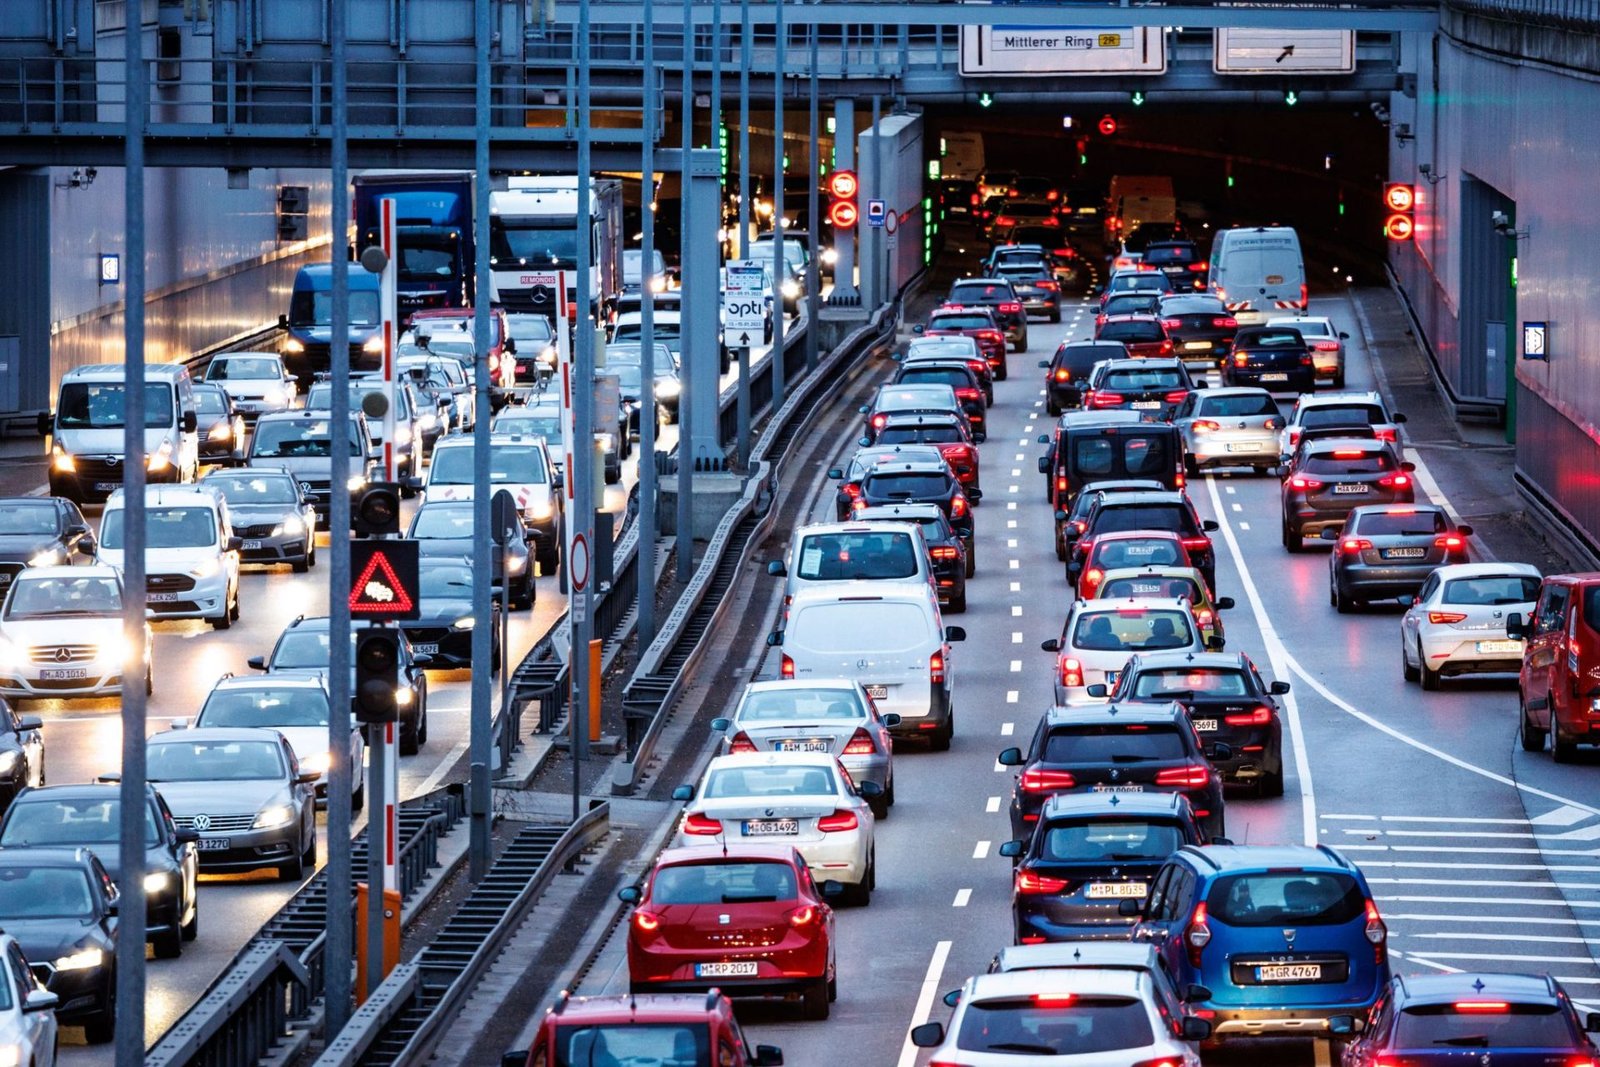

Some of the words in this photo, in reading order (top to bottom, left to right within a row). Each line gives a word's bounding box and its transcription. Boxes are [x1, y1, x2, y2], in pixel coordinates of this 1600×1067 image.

[1004, 36, 1059, 48] Mittlerer
[1065, 36, 1093, 49] Ring
[1103, 36, 1115, 45] 2R
[521, 276, 555, 284] REMONDIS
[728, 300, 762, 318] opti
[66, 670, 85, 678] 1016
[804, 743, 825, 752] 1040
[774, 822, 797, 832] 1492
[205, 840, 229, 849] 1270
[1105, 885, 1117, 895] PL
[1120, 885, 1145, 895] 8035
[701, 966, 709, 975] M
[715, 965, 728, 974] RP
[730, 963, 756, 974] 2017
[1262, 969, 1269, 978] M
[1276, 967, 1290, 978] GR
[1291, 966, 1319, 977] 4767
